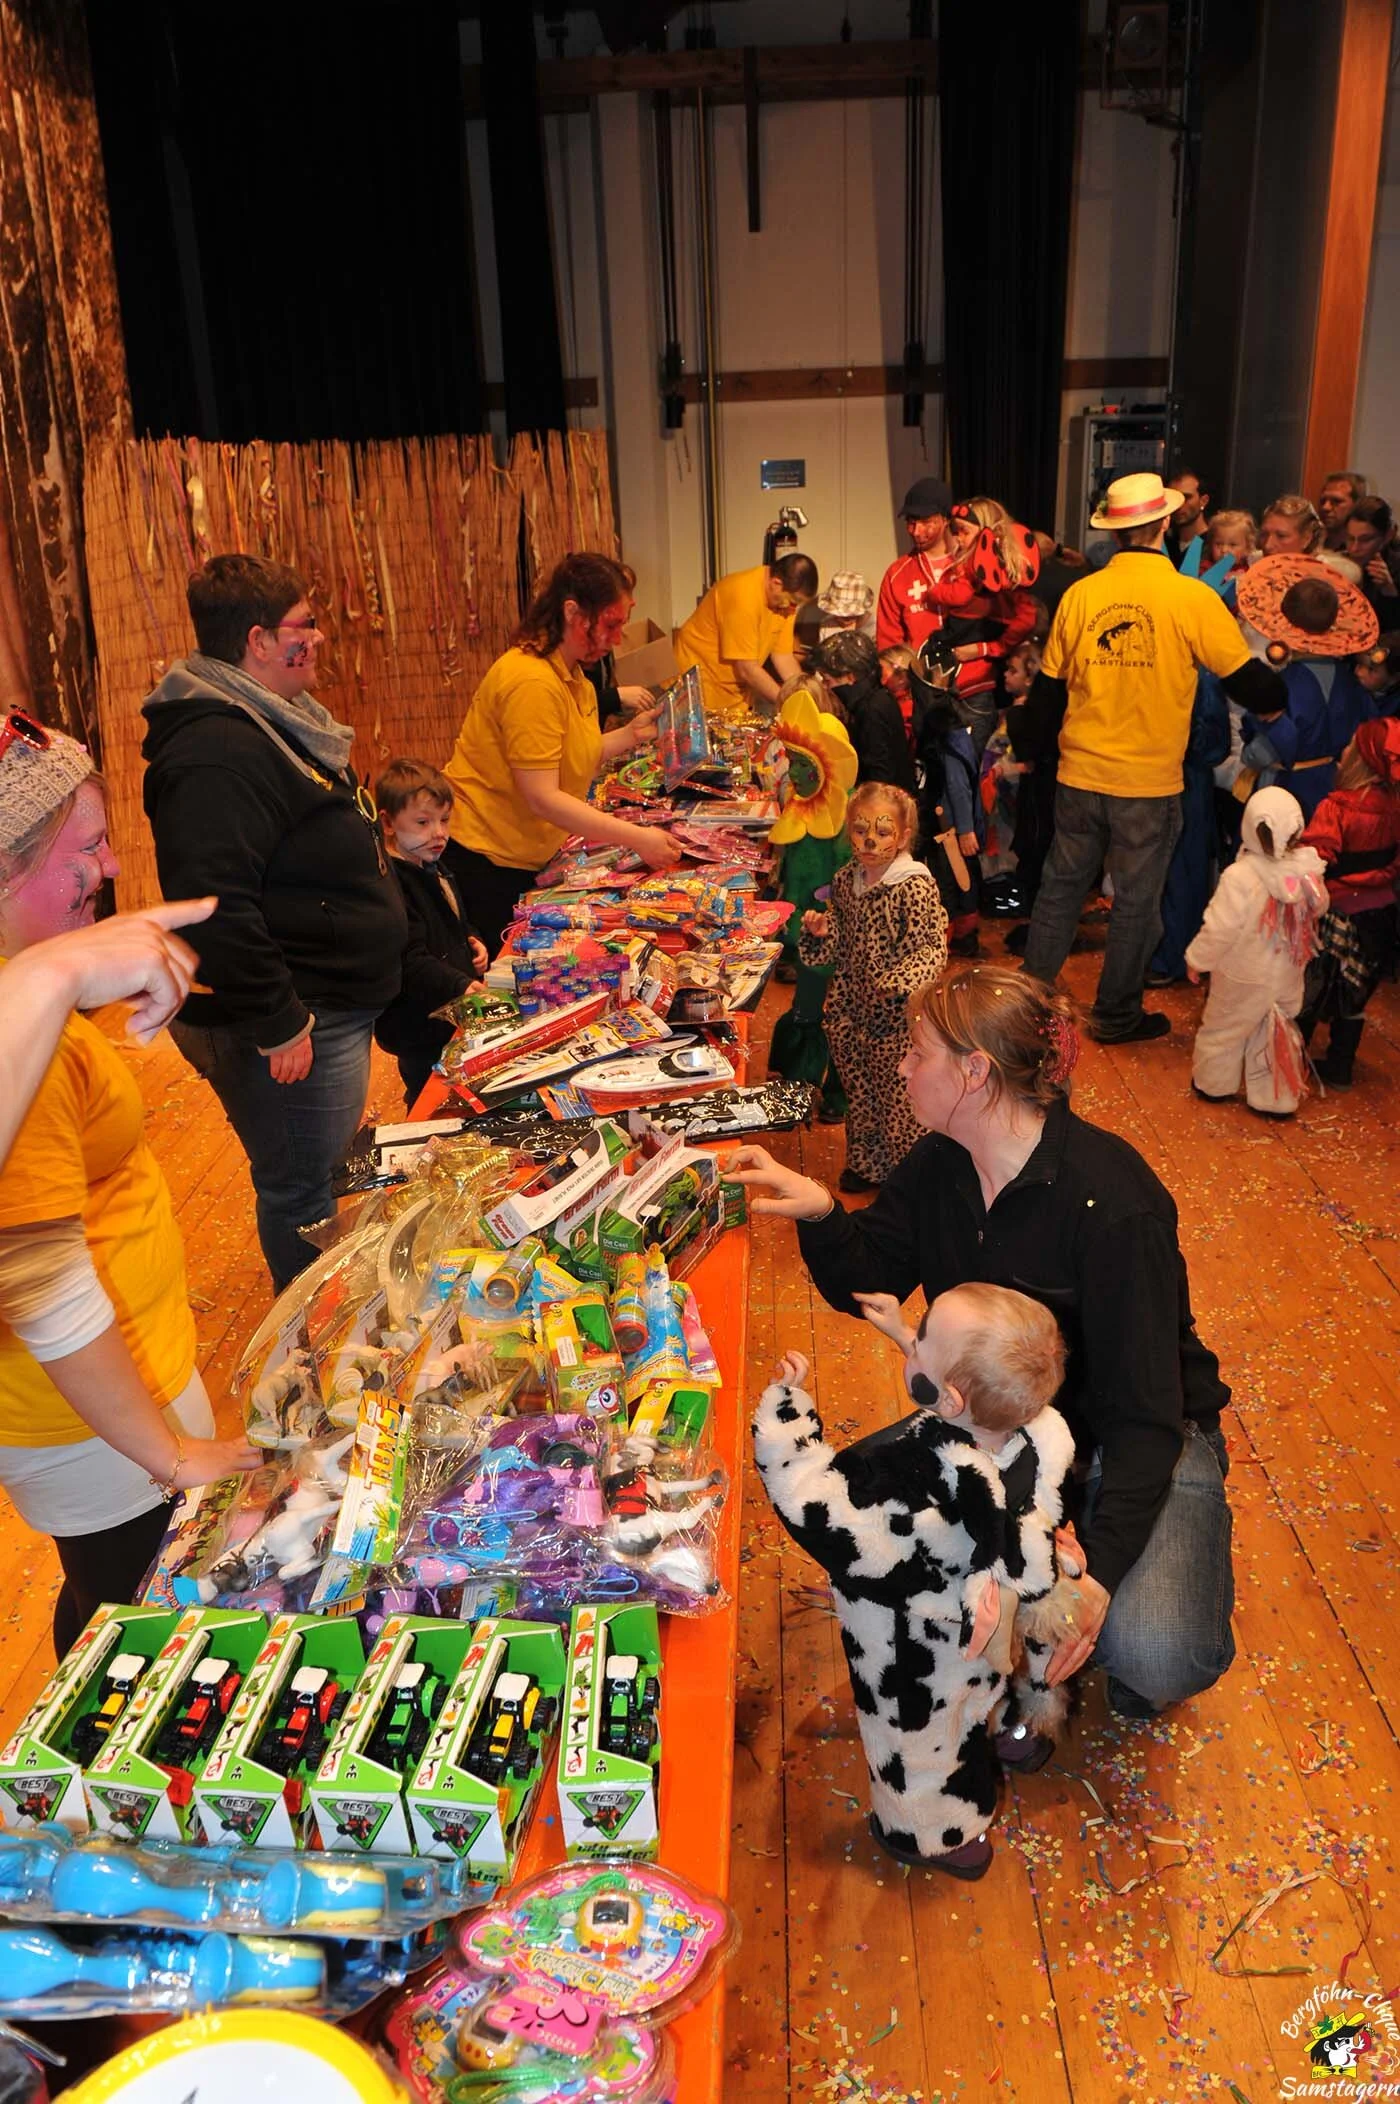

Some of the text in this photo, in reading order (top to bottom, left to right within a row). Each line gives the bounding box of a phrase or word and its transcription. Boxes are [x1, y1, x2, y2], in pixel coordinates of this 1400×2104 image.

[20, 1778, 49, 1789] BEST
[111, 1791, 140, 1803] BEST
[591, 1793, 621, 1804] BEST
[225, 1797, 256, 1809] BEST
[342, 1802, 372, 1813] BEST
[439, 1809, 468, 1820] BEST
